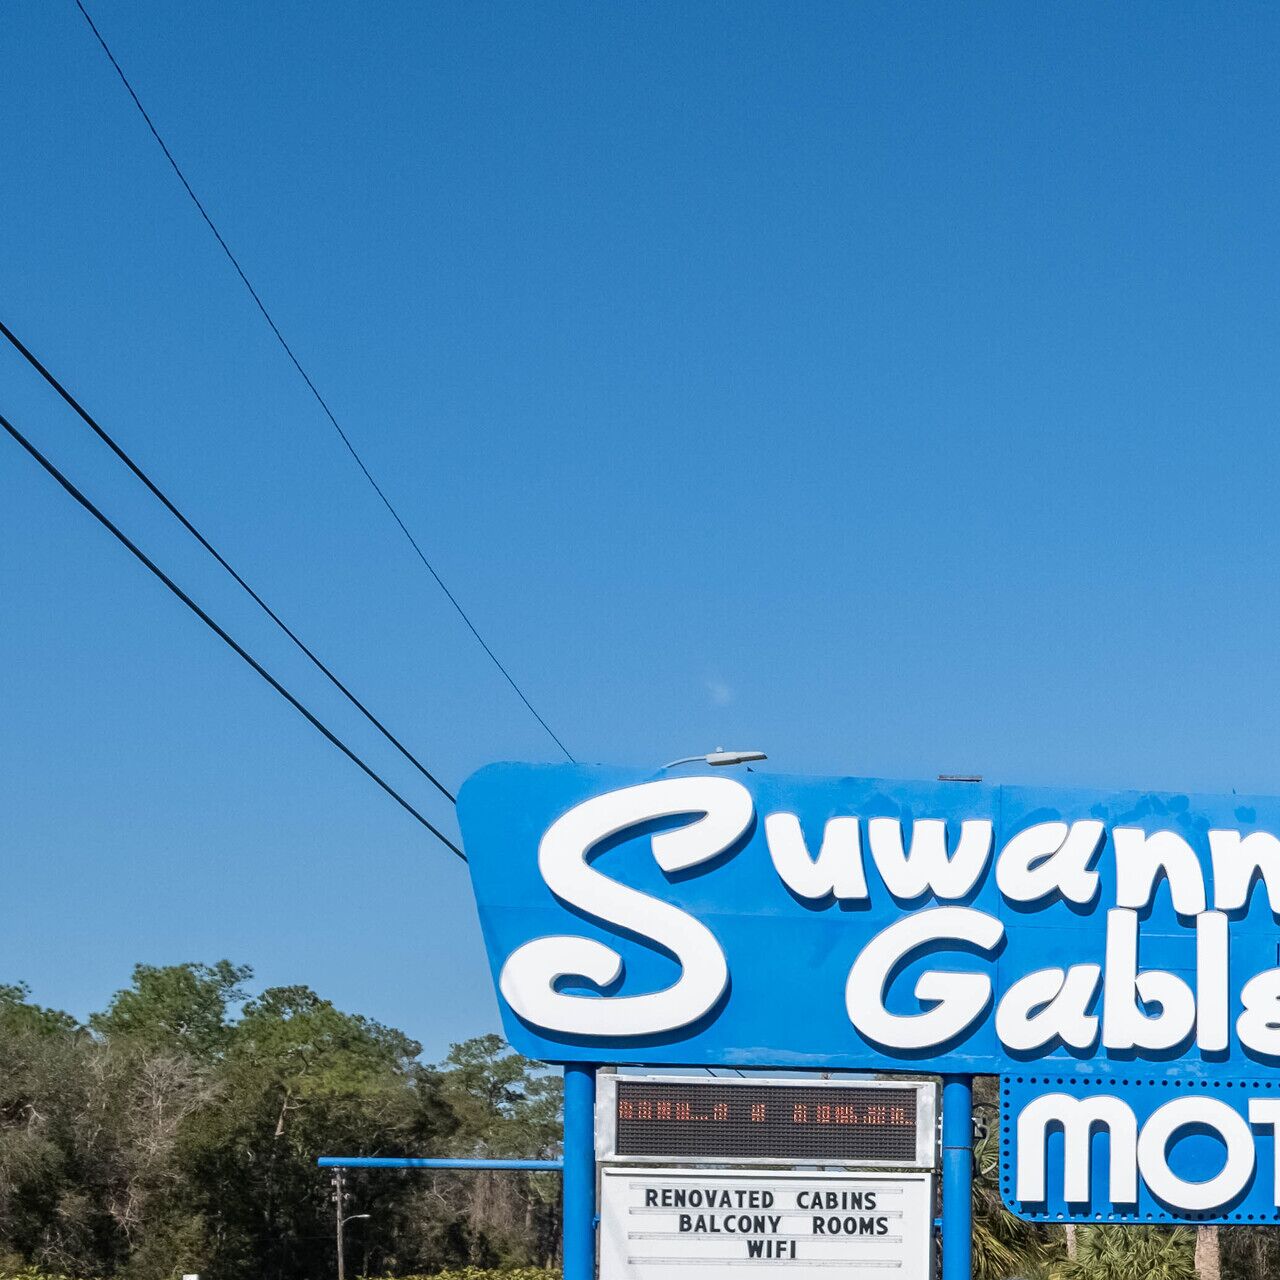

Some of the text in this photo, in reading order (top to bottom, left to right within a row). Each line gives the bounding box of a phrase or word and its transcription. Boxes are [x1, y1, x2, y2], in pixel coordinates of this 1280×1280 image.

[645, 1188, 877, 1211] RENOVATED CABINS
[679, 1214, 889, 1236] BALCONY ROOMS
[747, 1240, 797, 1259] WIFI
